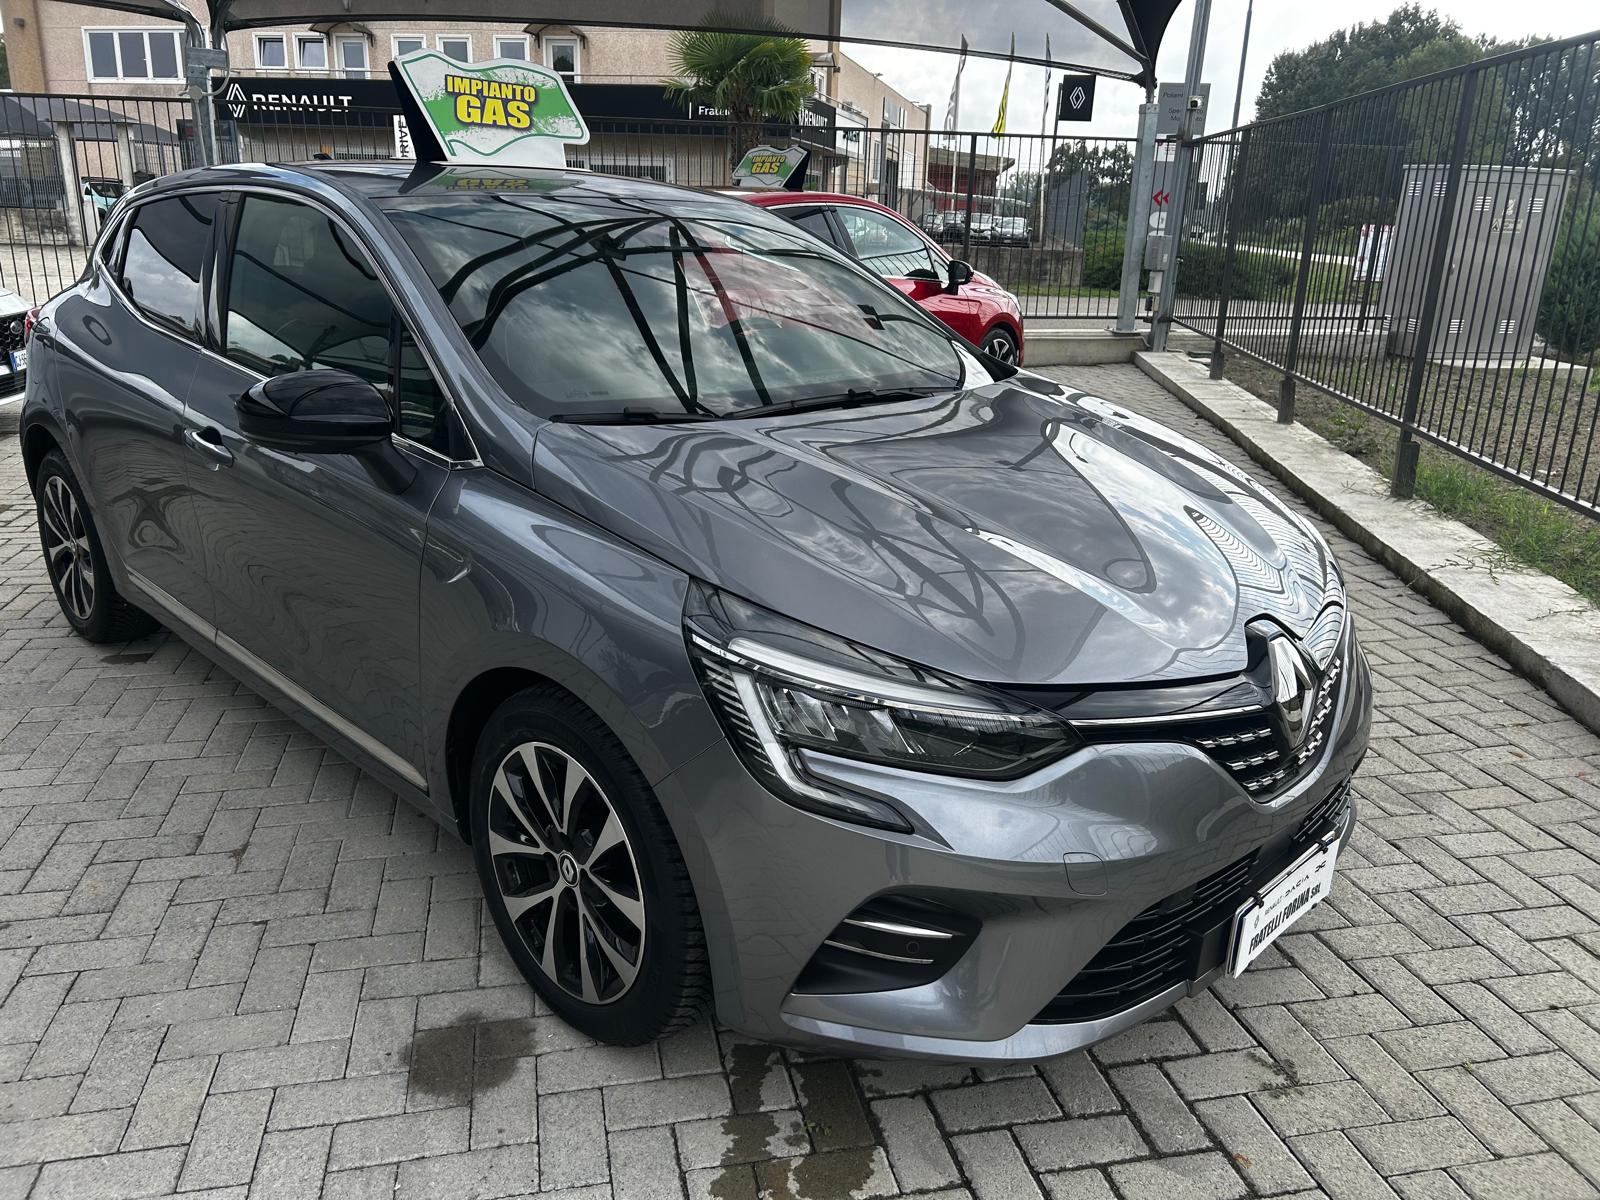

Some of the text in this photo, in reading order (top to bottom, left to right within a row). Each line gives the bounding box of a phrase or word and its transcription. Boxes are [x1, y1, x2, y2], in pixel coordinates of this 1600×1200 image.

[446, 75, 536, 102] IMPIANTO
[252, 94, 352, 112] RENAULT
[456, 94, 531, 128] GAS
[698, 105, 731, 116] Fratll
[751, 162, 781, 174] GAS
[752, 155, 786, 163] IMPIANTO
[1285, 874, 1309, 897] DACIA
[1248, 911, 1283, 954] FRATELLI
[1310, 882, 1321, 899] SRL
